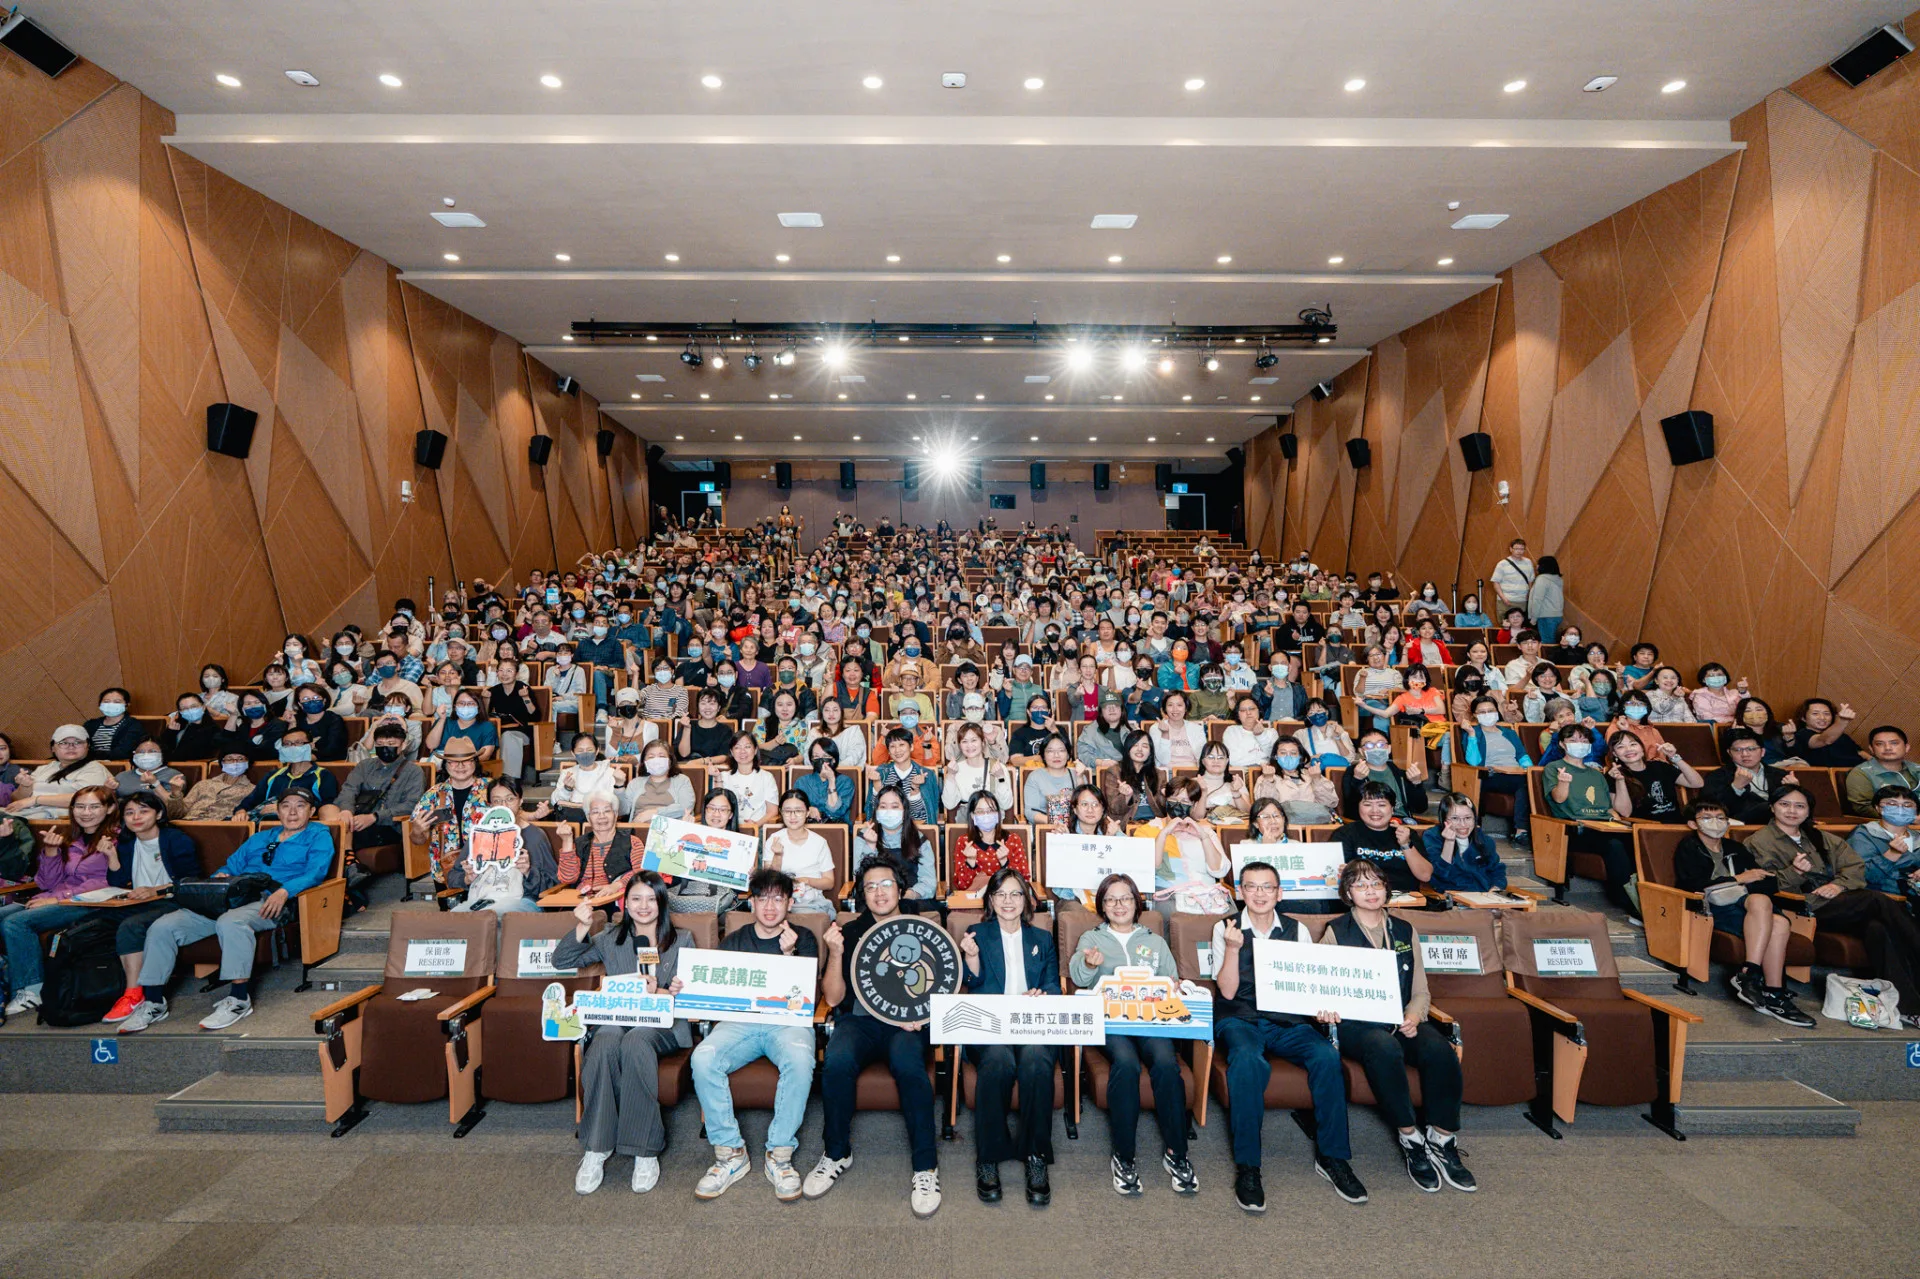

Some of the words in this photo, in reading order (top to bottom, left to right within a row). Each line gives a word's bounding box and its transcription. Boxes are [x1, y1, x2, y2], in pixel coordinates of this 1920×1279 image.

[1544, 833, 1551, 844] 3
[1097, 851, 1105, 859] 之
[1356, 847, 1405, 858] Democrac
[322, 897, 328, 908] 2
[1660, 906, 1667, 918] 2
[425, 946, 451, 956] 保留席
[906, 923, 955, 970] ACADEMY
[529, 951, 554, 964] 保留
[1428, 947, 1468, 960] 保留席
[418, 958, 455, 966] RESERVED
[1547, 958, 1584, 966] RESERVED
[690, 964, 768, 988] 質感講座
[607, 980, 644, 994] 2025
[859, 969, 909, 1018] ACADEMY
[575, 993, 671, 1013] 高雄城市書展
[584, 1013, 614, 1021] KAOHSIUNG
[638, 1016, 661, 1024] FESTIVAL
[1010, 1012, 1094, 1025] 高雄市立圖書館
[1010, 1028, 1046, 1036] Kaohsiung
[1069, 1028, 1094, 1036] Library
